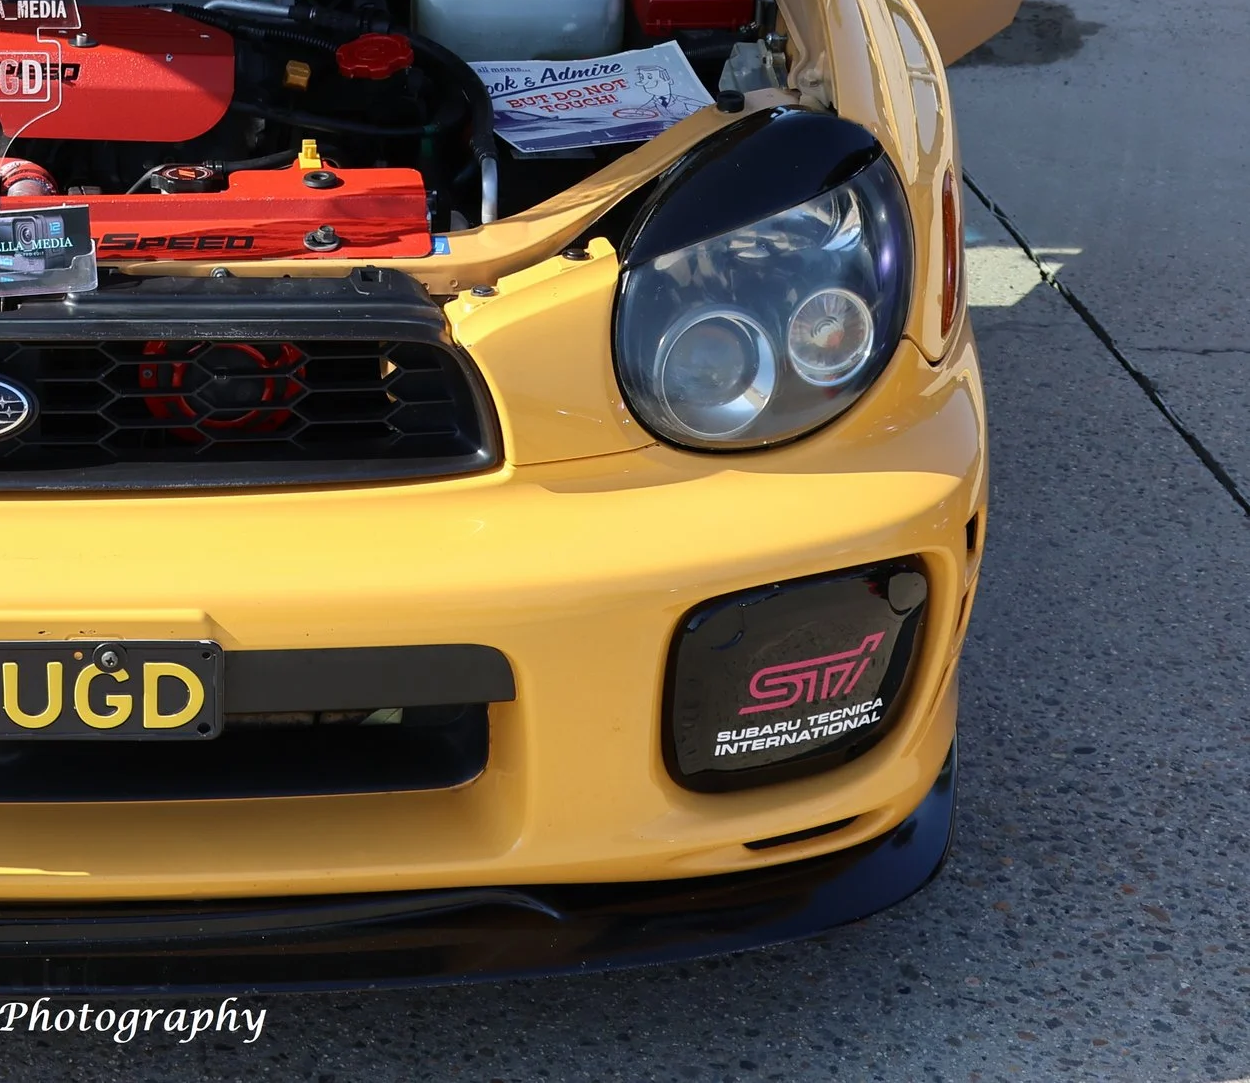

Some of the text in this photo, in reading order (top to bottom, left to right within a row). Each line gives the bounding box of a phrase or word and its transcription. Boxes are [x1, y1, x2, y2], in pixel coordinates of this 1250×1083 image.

[487, 62, 624, 94] ook & Admire
[506, 78, 629, 109] BUT DO NOT
[539, 94, 620, 113] TOUCH!
[49, 221, 62, 233] 12
[96, 233, 255, 251] SPEED
[714, 711, 882, 757] INTERNATIONAL
[716, 697, 884, 743] SUBARU TECNICA
